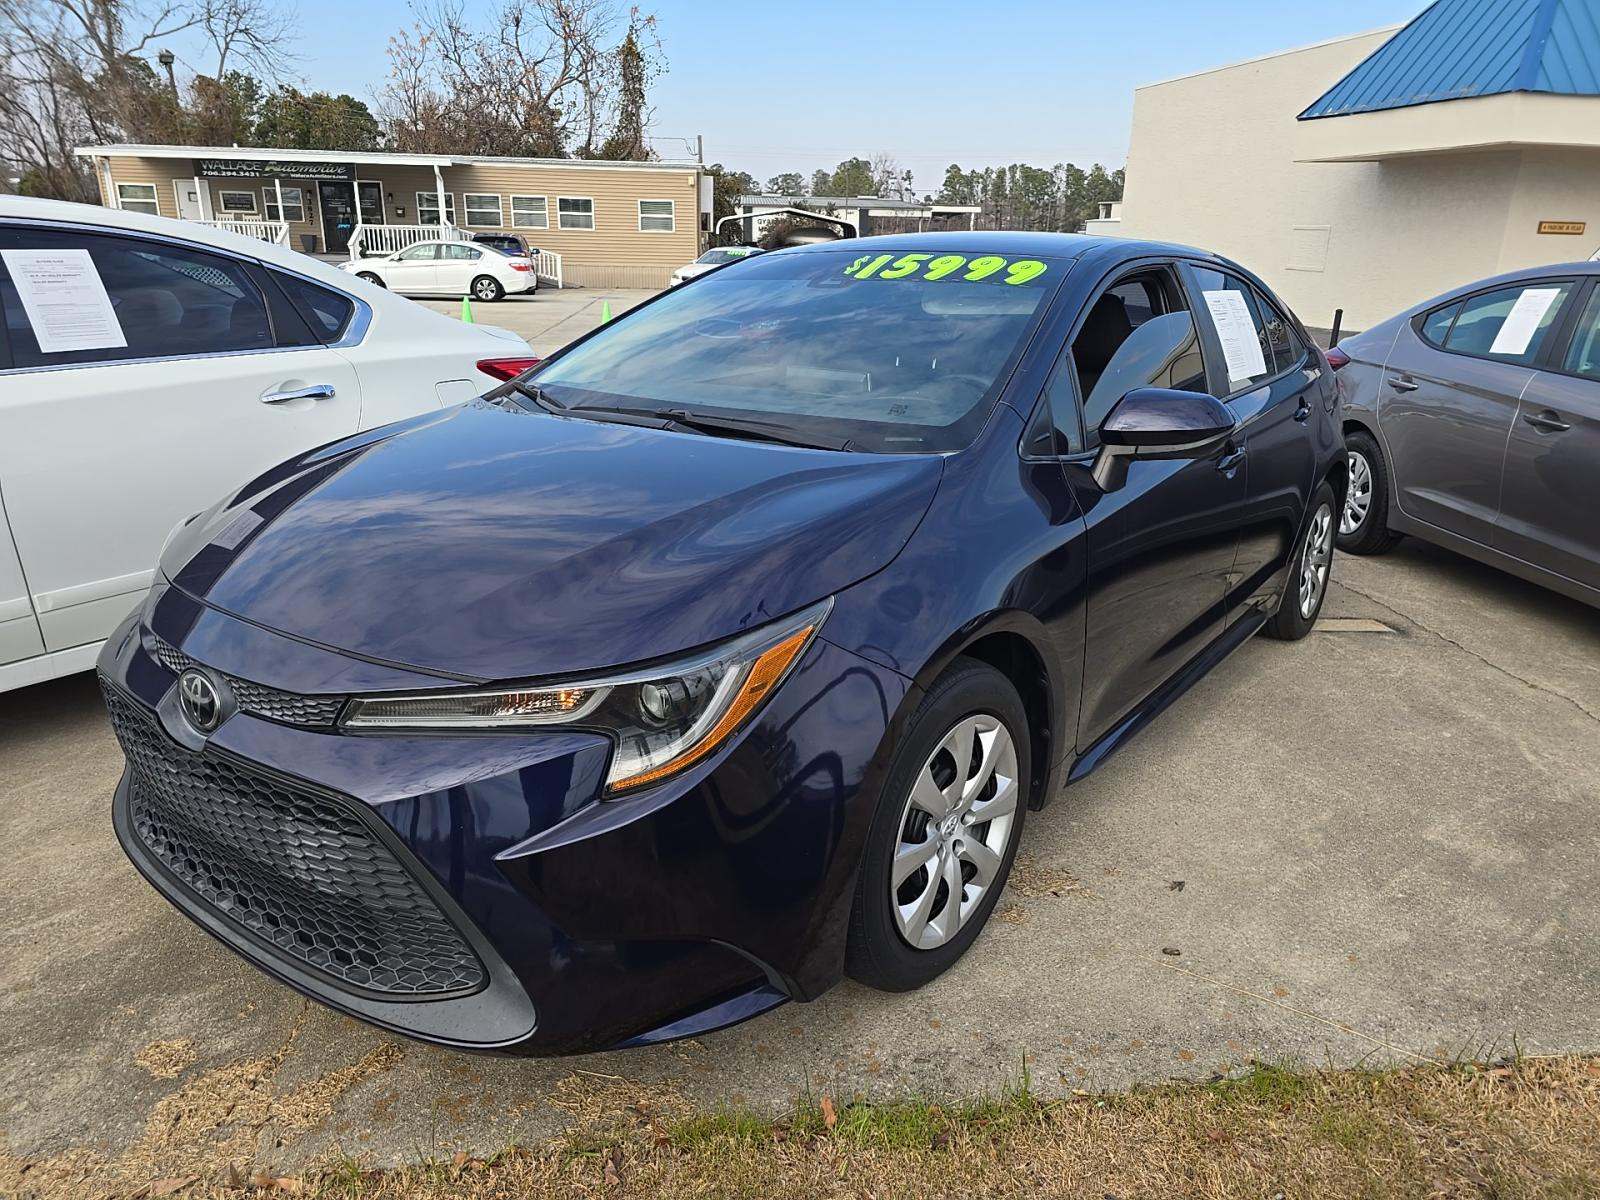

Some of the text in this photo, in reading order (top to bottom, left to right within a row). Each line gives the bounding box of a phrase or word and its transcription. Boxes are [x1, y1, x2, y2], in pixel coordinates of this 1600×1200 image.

[200, 160, 346, 174] WALLACE Automotive
[844, 253, 1048, 285] $15999
